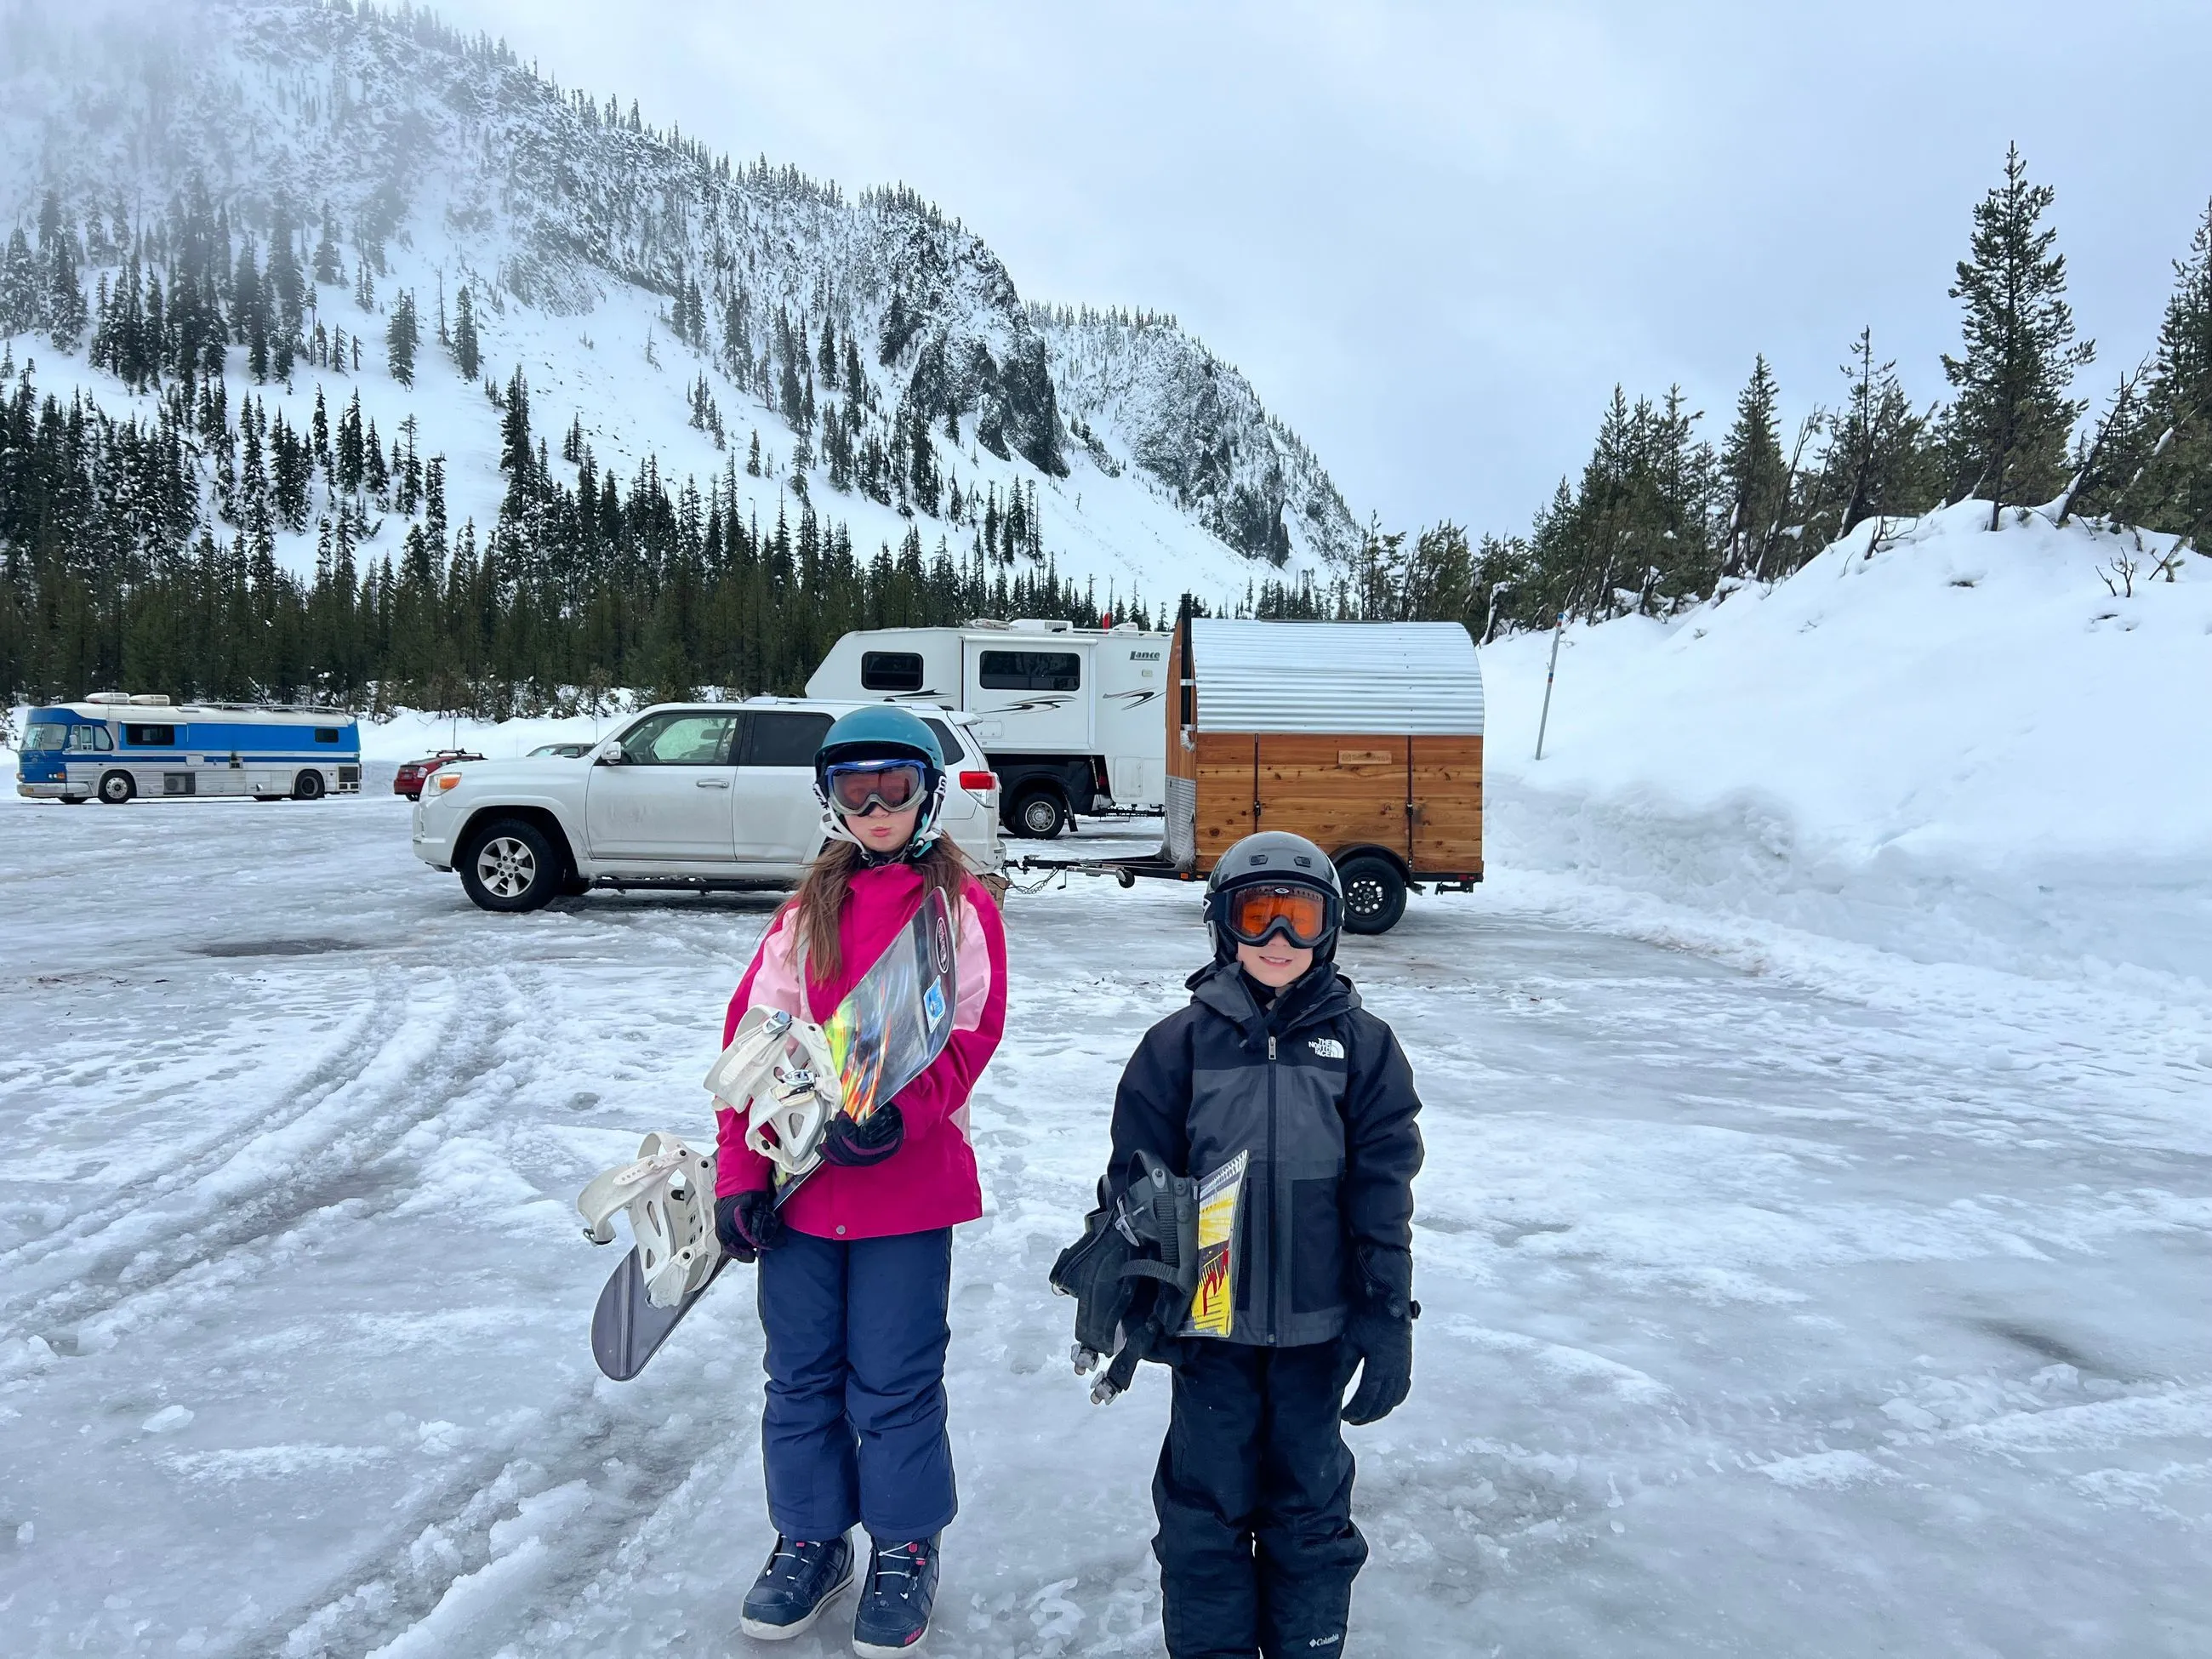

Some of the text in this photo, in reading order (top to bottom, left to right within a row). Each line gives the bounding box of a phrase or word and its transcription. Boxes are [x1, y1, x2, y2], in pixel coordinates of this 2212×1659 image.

[1129, 651, 1160, 661] Lance
[1308, 1041, 1331, 1051] NORTH
[1314, 1049, 1331, 1058] FACE
[1316, 1633, 1339, 1647] Columbia
